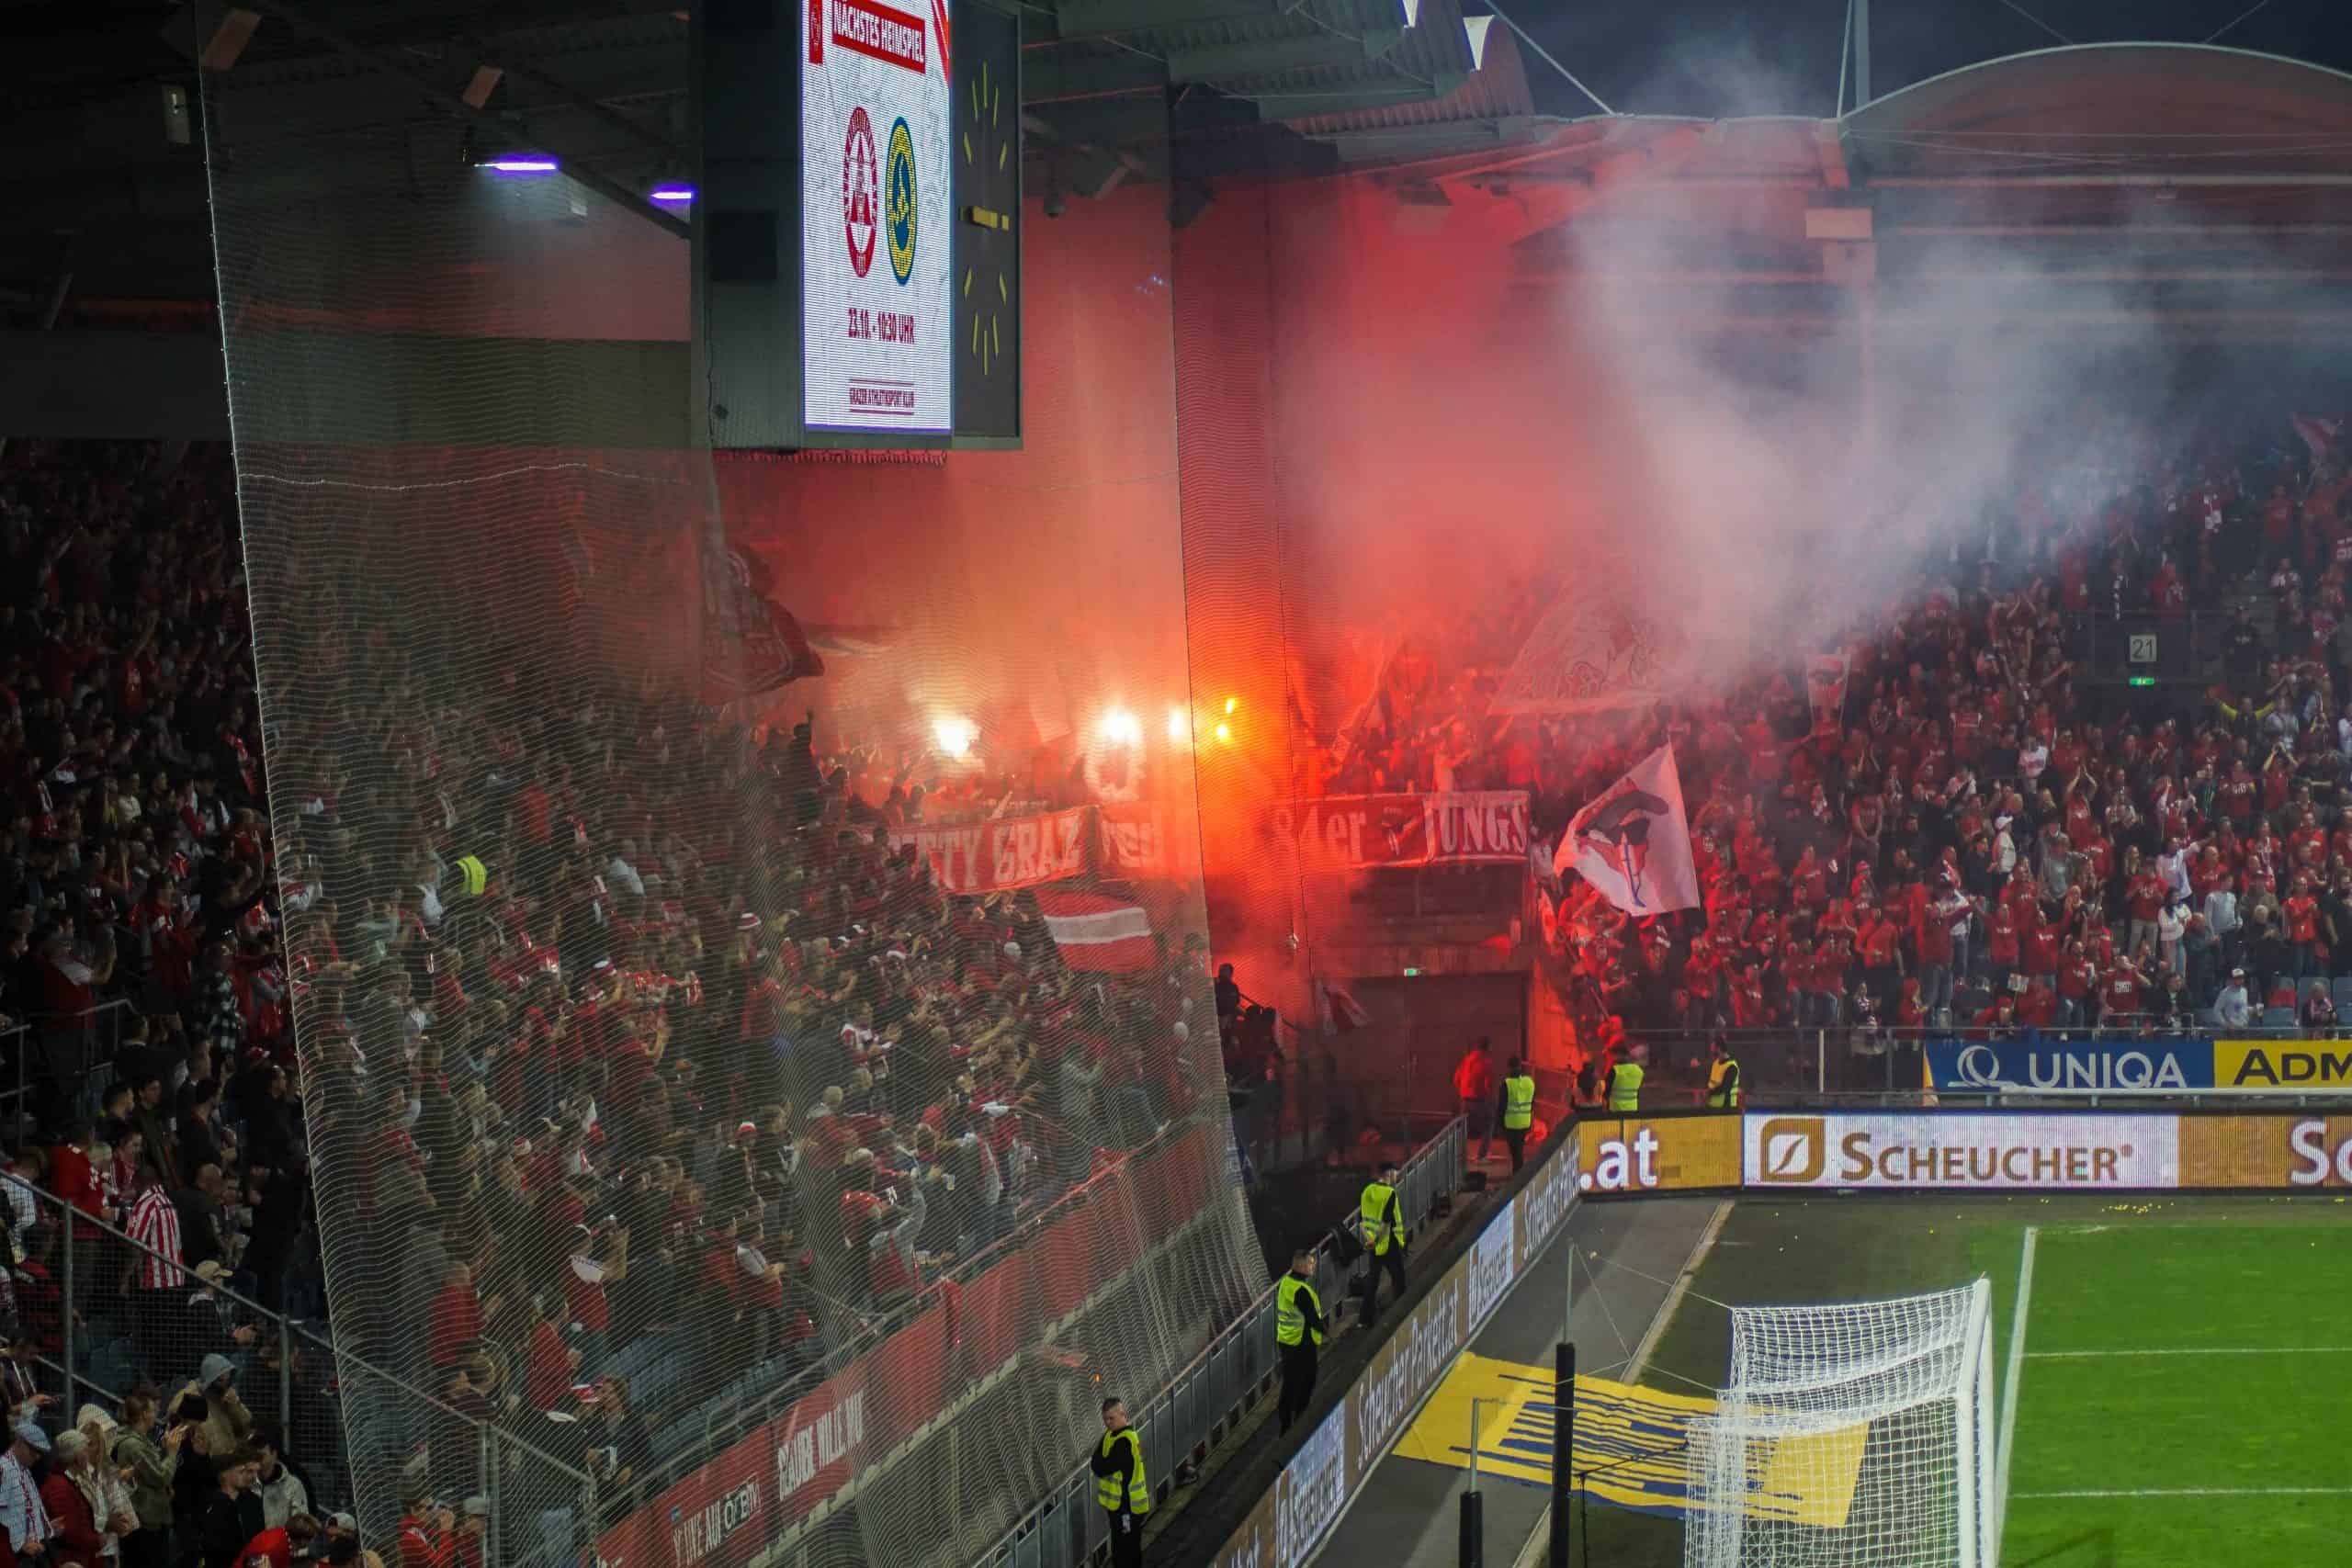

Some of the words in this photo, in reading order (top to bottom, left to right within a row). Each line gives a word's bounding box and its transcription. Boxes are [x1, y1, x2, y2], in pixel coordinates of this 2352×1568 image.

[833, 0, 879, 49] NÄCHSTES
[881, 17, 924, 63] HEIMSPIEL
[899, 314, 915, 344] UHR
[2132, 638, 2154, 660] 21
[992, 814, 1084, 884] GRAZ
[2029, 1051, 2188, 1089] UNIQA
[2233, 1049, 2352, 1086] ADM
